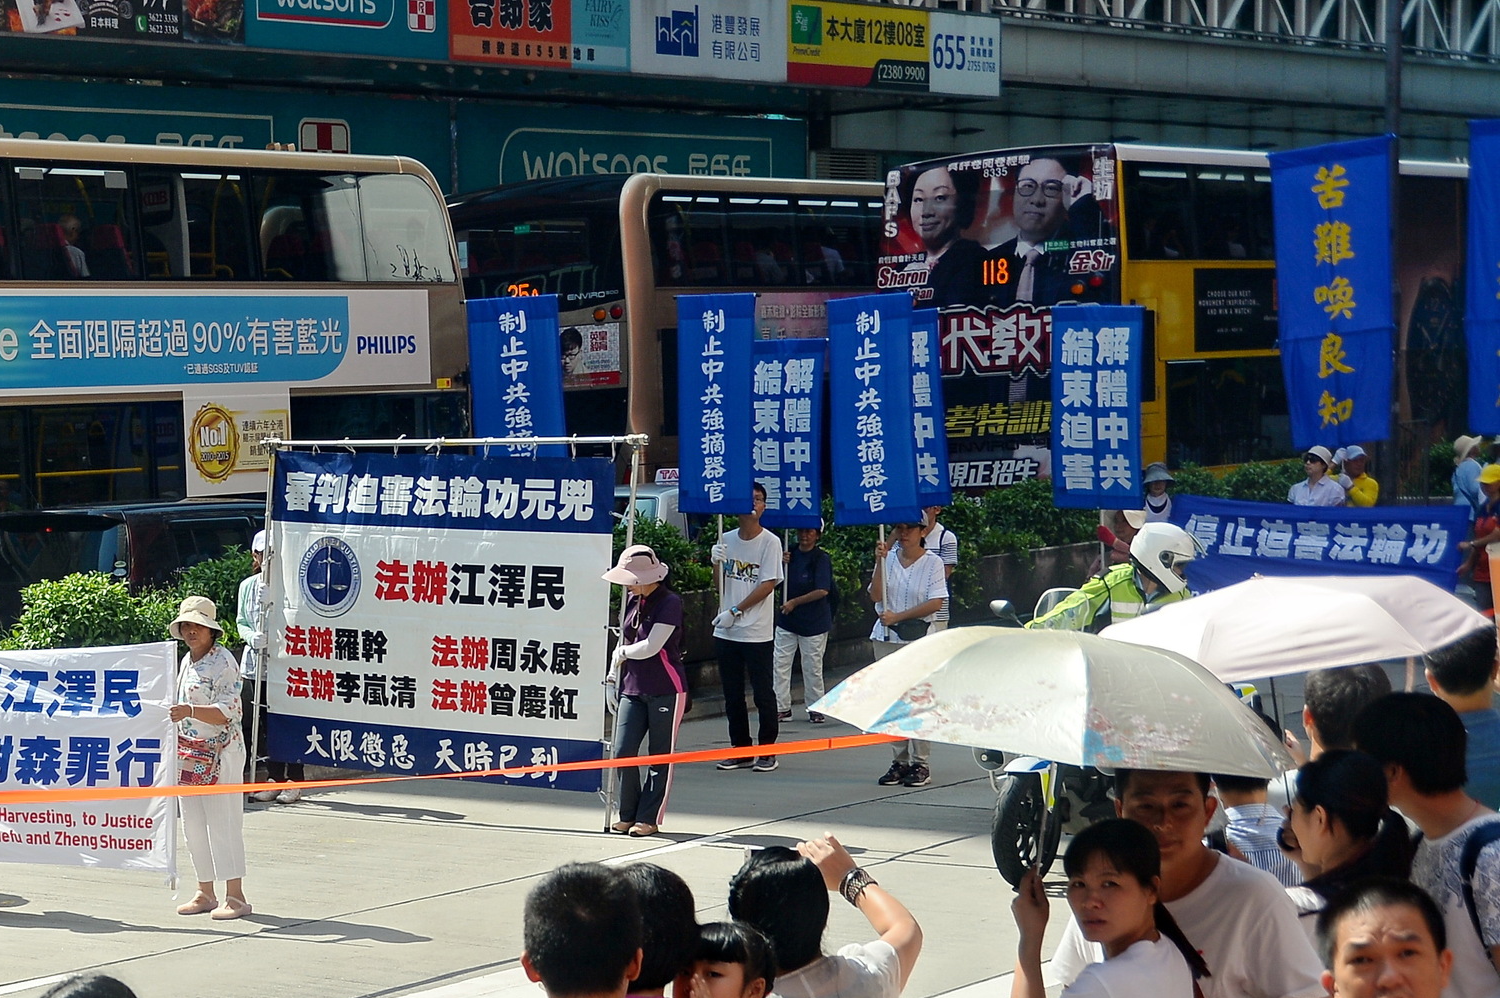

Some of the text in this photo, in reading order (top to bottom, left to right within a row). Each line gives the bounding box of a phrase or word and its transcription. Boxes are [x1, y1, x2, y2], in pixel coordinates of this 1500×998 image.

[91, 17, 119, 29] 日本料理
[590, 15, 610, 27] KISS
[712, 14, 760, 37] 港豐發展
[826, 16, 926, 48] 本大廈12樓08室
[712, 41, 760, 62] 有限公司
[933, 34, 966, 70] 655
[882, 64, 925, 81] 2380 9900
[983, 167, 1008, 178] 8335
[877, 266, 929, 289] Sharon
[983, 258, 1009, 286] 118
[1311, 164, 1356, 430] 苦難喚良知
[356, 334, 417, 355] PHILIPS
[939, 308, 1053, 370] 代教
[499, 310, 534, 458] 制止中共強摘
[701, 309, 726, 503] 制止中共強摘器官
[854, 310, 888, 513] 制止中共強摘器官
[1060, 328, 1096, 491] 結束迫害
[1096, 327, 1133, 491] 解體中共
[200, 420, 228, 447] No.1
[783, 358, 816, 510] 解體中共
[660, 470, 679, 479] TA
[285, 471, 595, 521] 審判迫害法輪功元兇
[1184, 513, 1448, 565] 停止迫害法輪功
[374, 559, 565, 611] 法辦江澤民
[284, 625, 388, 664] 法辦羅幹
[431, 635, 581, 676] 法辦周永康
[286, 667, 417, 709] 法辦李嵐清
[431, 679, 579, 720] 法辦曾慶紅
[434, 738, 559, 782] 天時已到
[83, 811, 96, 826] to
[101, 813, 153, 829] Justice
[26, 831, 50, 845] and
[55, 831, 98, 849] Zheng
[100, 835, 153, 850] Shusen
